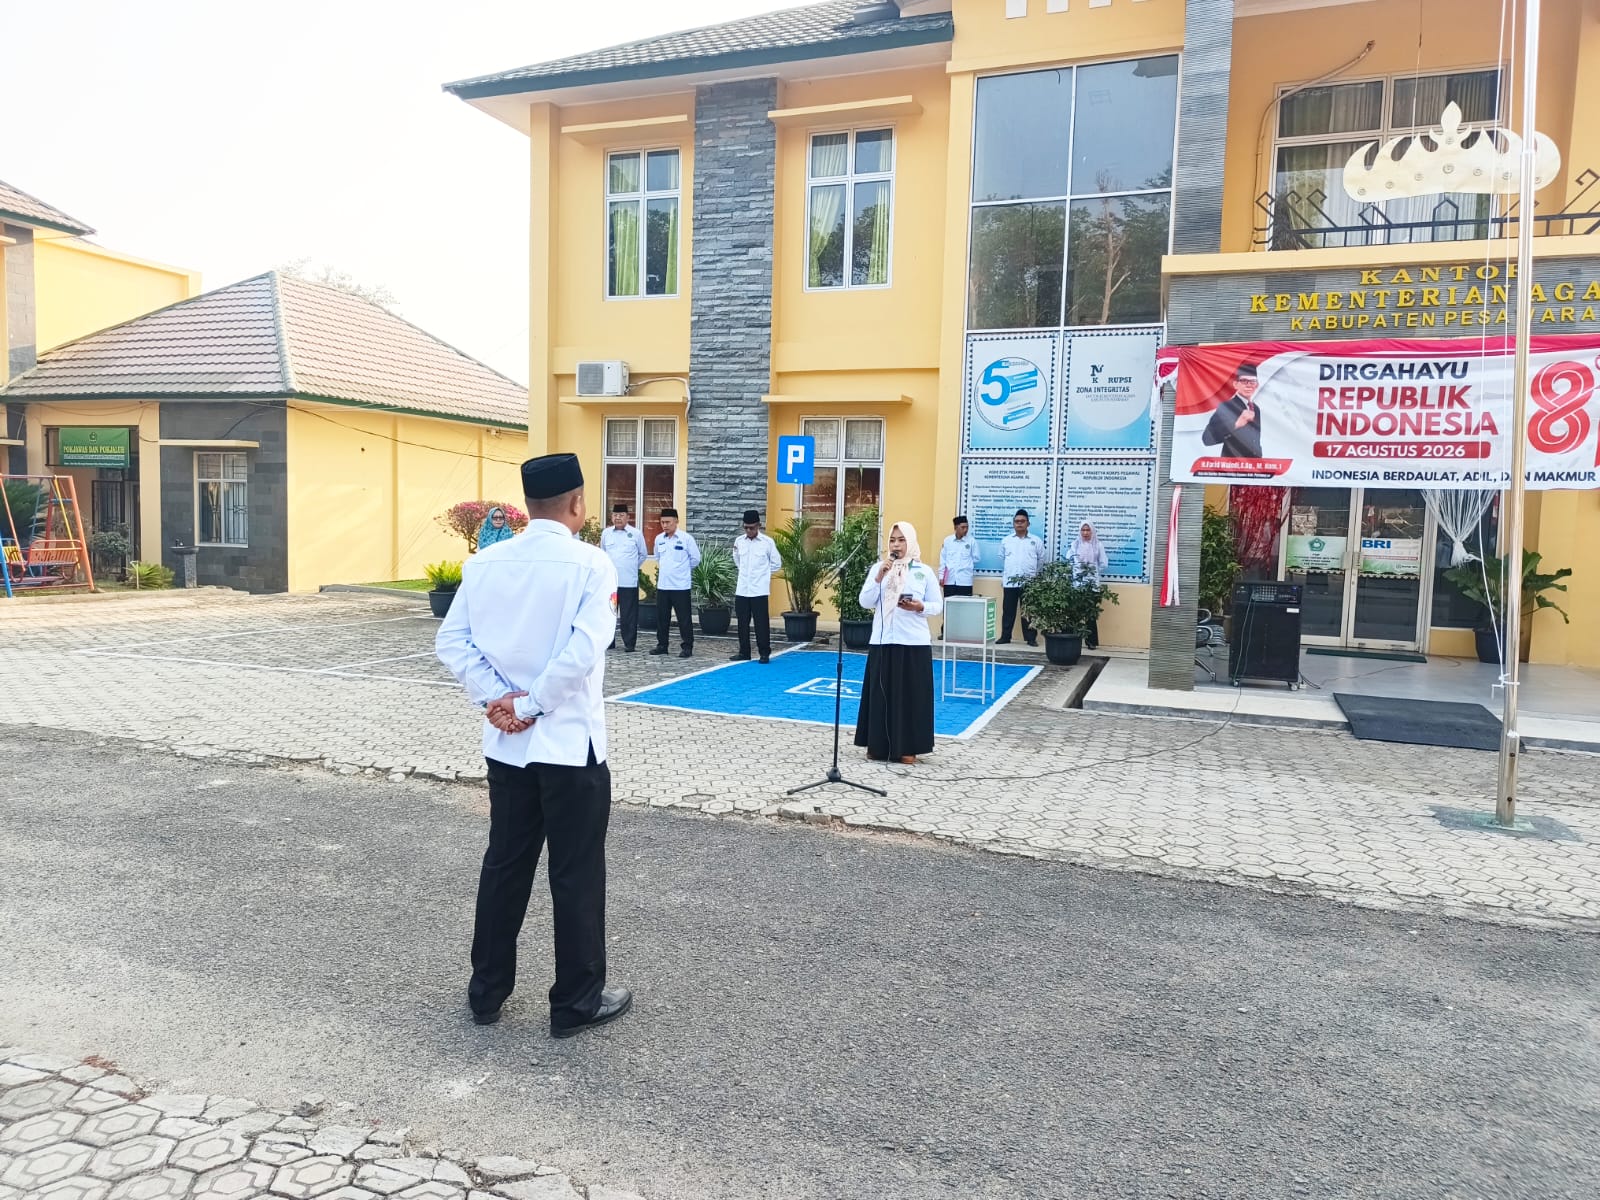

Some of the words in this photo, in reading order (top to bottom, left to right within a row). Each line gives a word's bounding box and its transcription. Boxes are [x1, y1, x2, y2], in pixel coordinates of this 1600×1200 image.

[1250, 284, 1511, 313] KEMENTERIAN
[1291, 312, 1435, 331] KABUPATEN
[1444, 306, 1596, 326] PESAARA
[980, 360, 1011, 406] 5
[1319, 361, 1469, 381] DIRGAHAYU
[1076, 386, 1092, 394] ZONA
[1318, 385, 1471, 411] REPUBLIK
[1316, 411, 1498, 436] INDONESIA
[786, 444, 805, 475] P
[1326, 444, 1343, 457] 17
[1345, 444, 1419, 458] AGUSTUS
[1422, 444, 1466, 457] 2026
[1312, 469, 1379, 481] INDONESIA
[1383, 470, 1458, 482] BERDAULAT,
[1462, 470, 1497, 482] ADIL,
[1500, 471, 1531, 482] DN
[1534, 471, 1596, 482] MAKMUR
[1362, 539, 1391, 549] BRI
